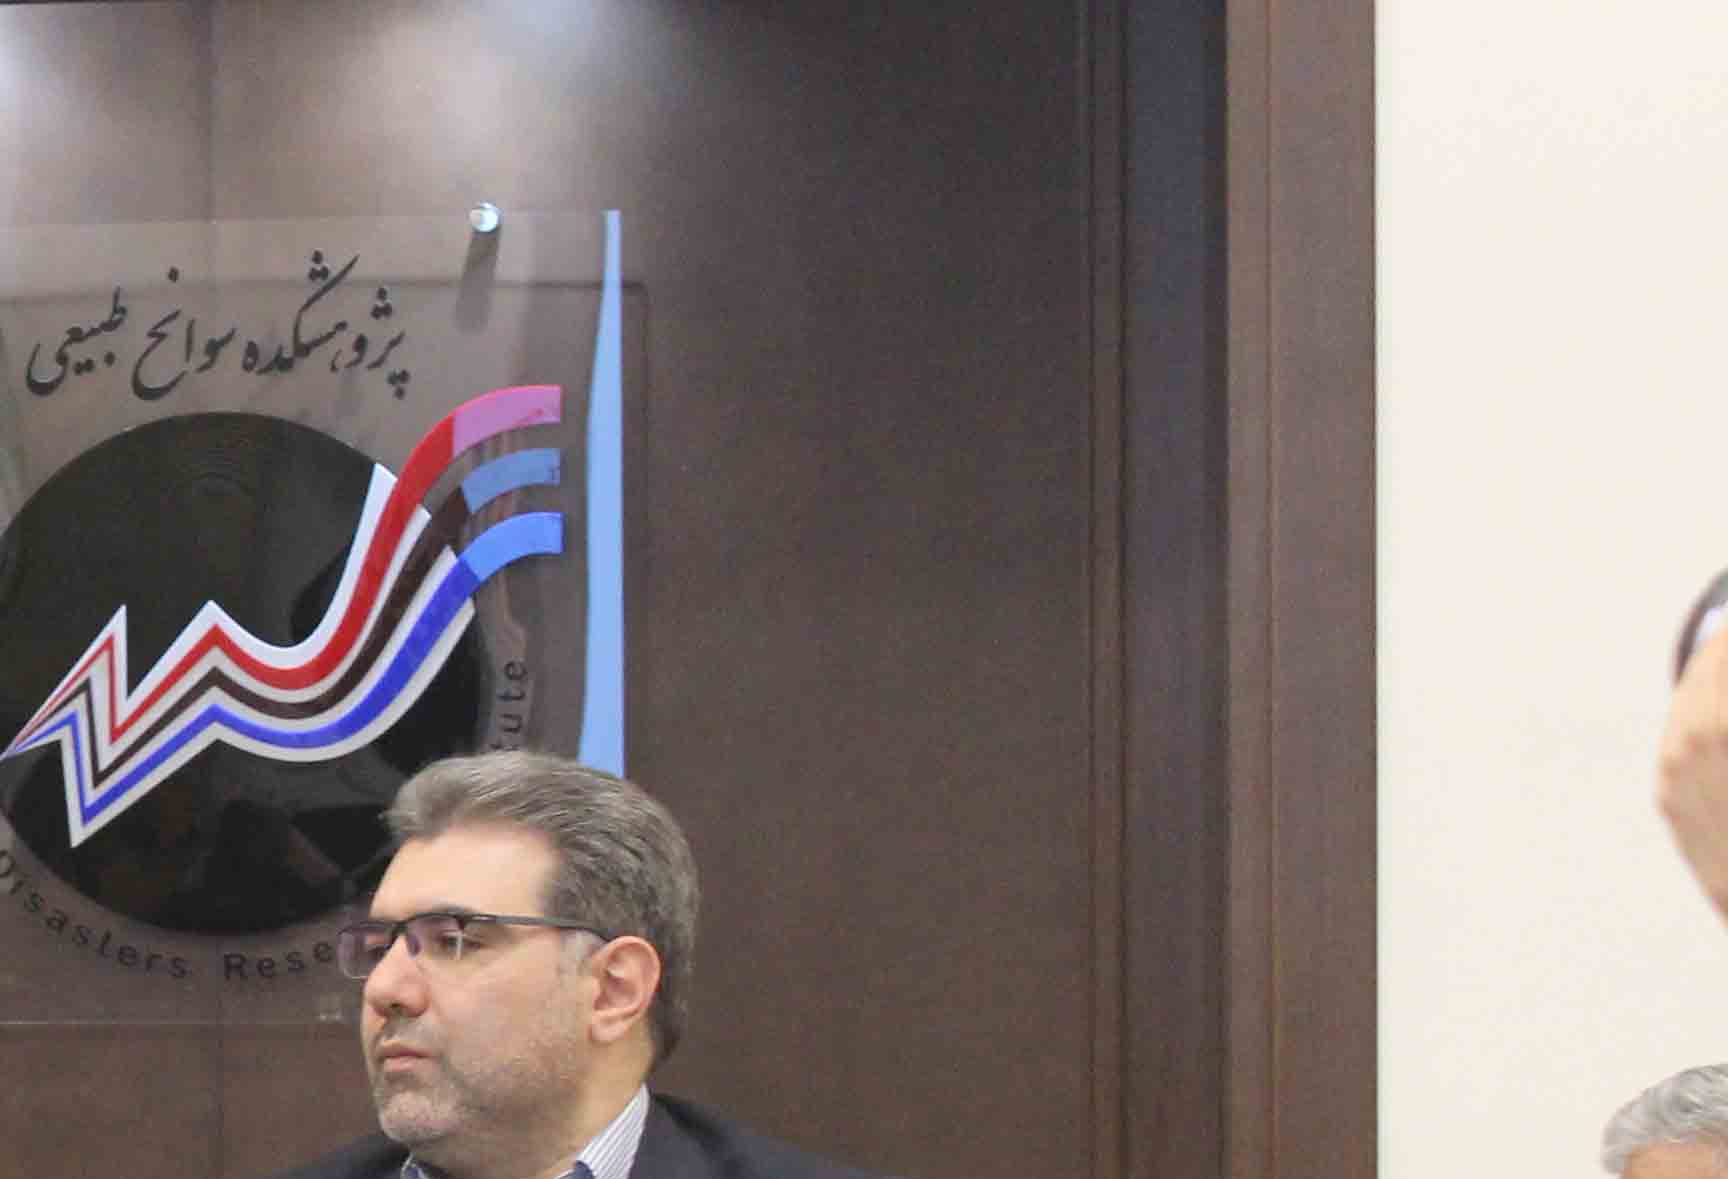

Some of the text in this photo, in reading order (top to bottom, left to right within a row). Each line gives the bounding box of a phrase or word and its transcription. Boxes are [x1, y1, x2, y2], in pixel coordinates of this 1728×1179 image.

[26, 250, 410, 400] پژوهشکده سوانح طبیعی
[223, 942, 333, 981] Rese
